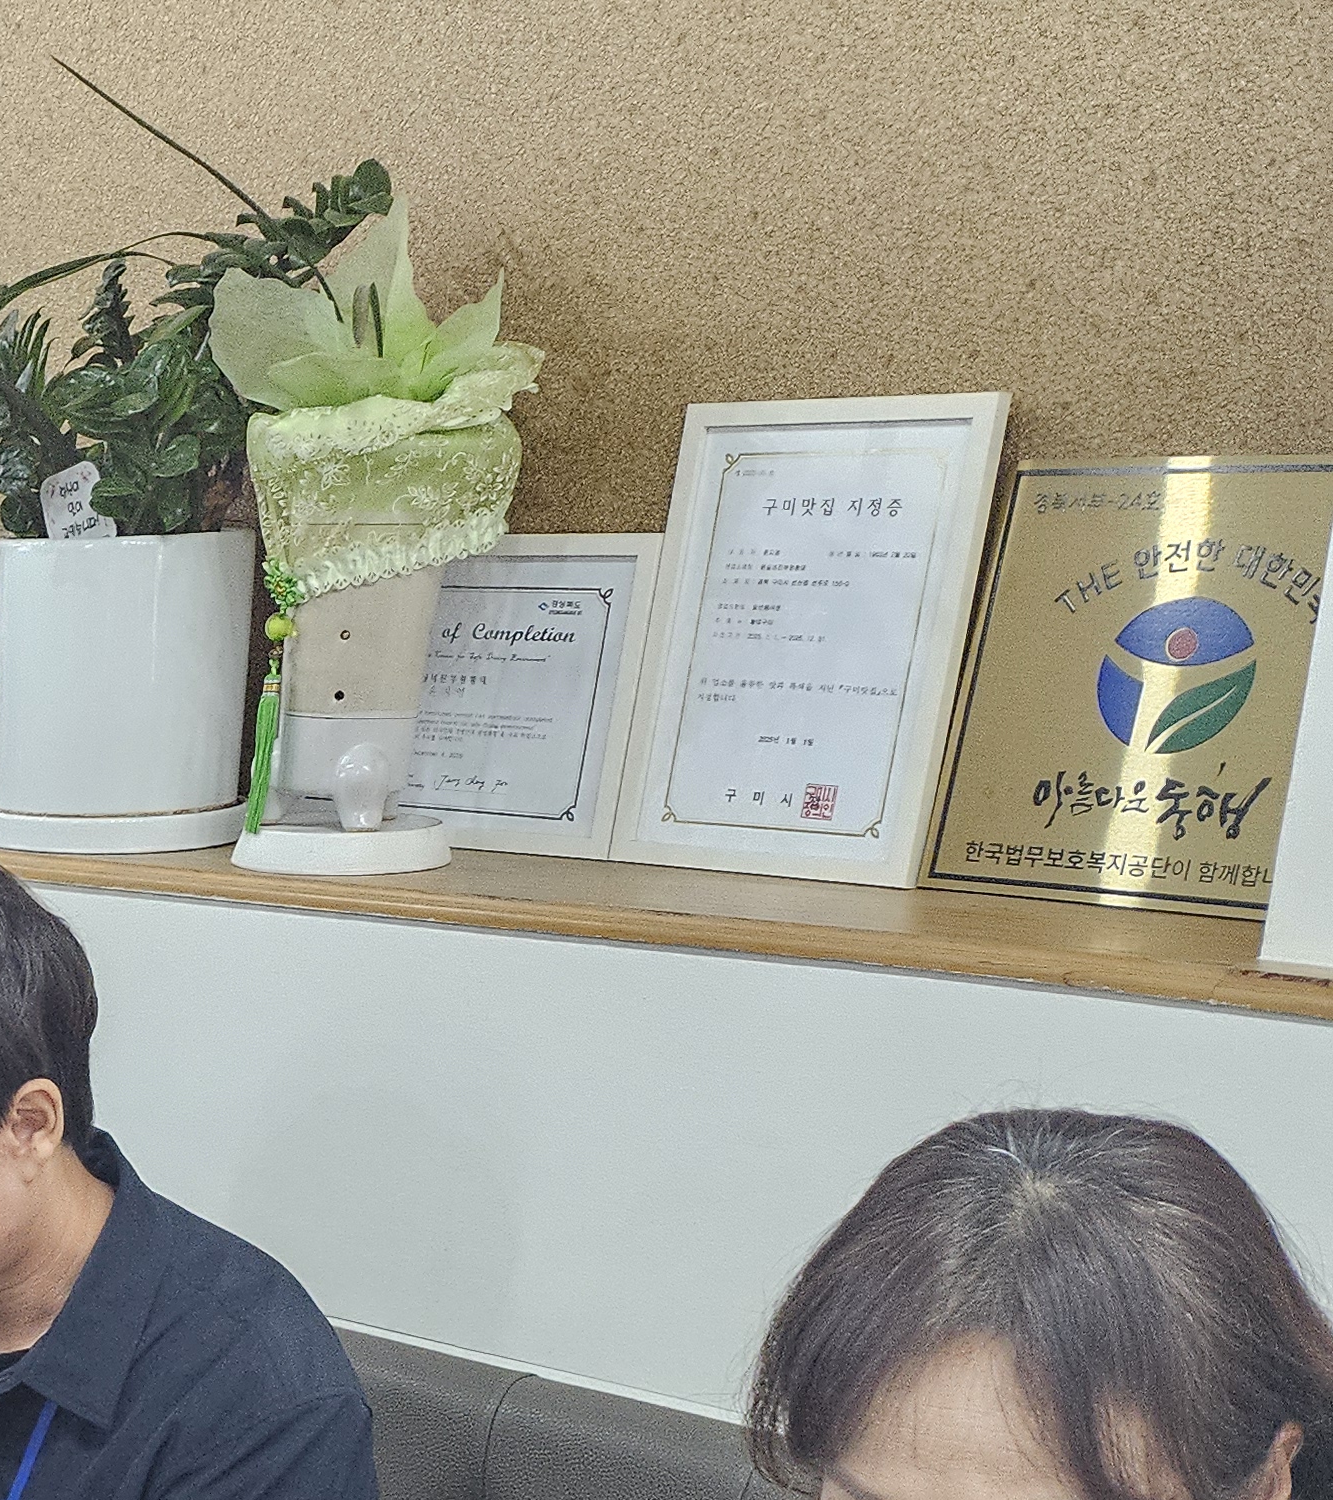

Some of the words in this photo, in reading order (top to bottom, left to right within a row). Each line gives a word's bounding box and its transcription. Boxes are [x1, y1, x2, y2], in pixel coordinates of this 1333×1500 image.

[762, 497, 835, 516] 구미맛집
[847, 497, 903, 517] 지정증
[1054, 560, 1123, 613] THE
[1134, 538, 1225, 580] 안전한
[442, 622, 463, 644] of
[472, 623, 577, 646] Completion
[965, 840, 1190, 881] 한국법무보호복지공단이
